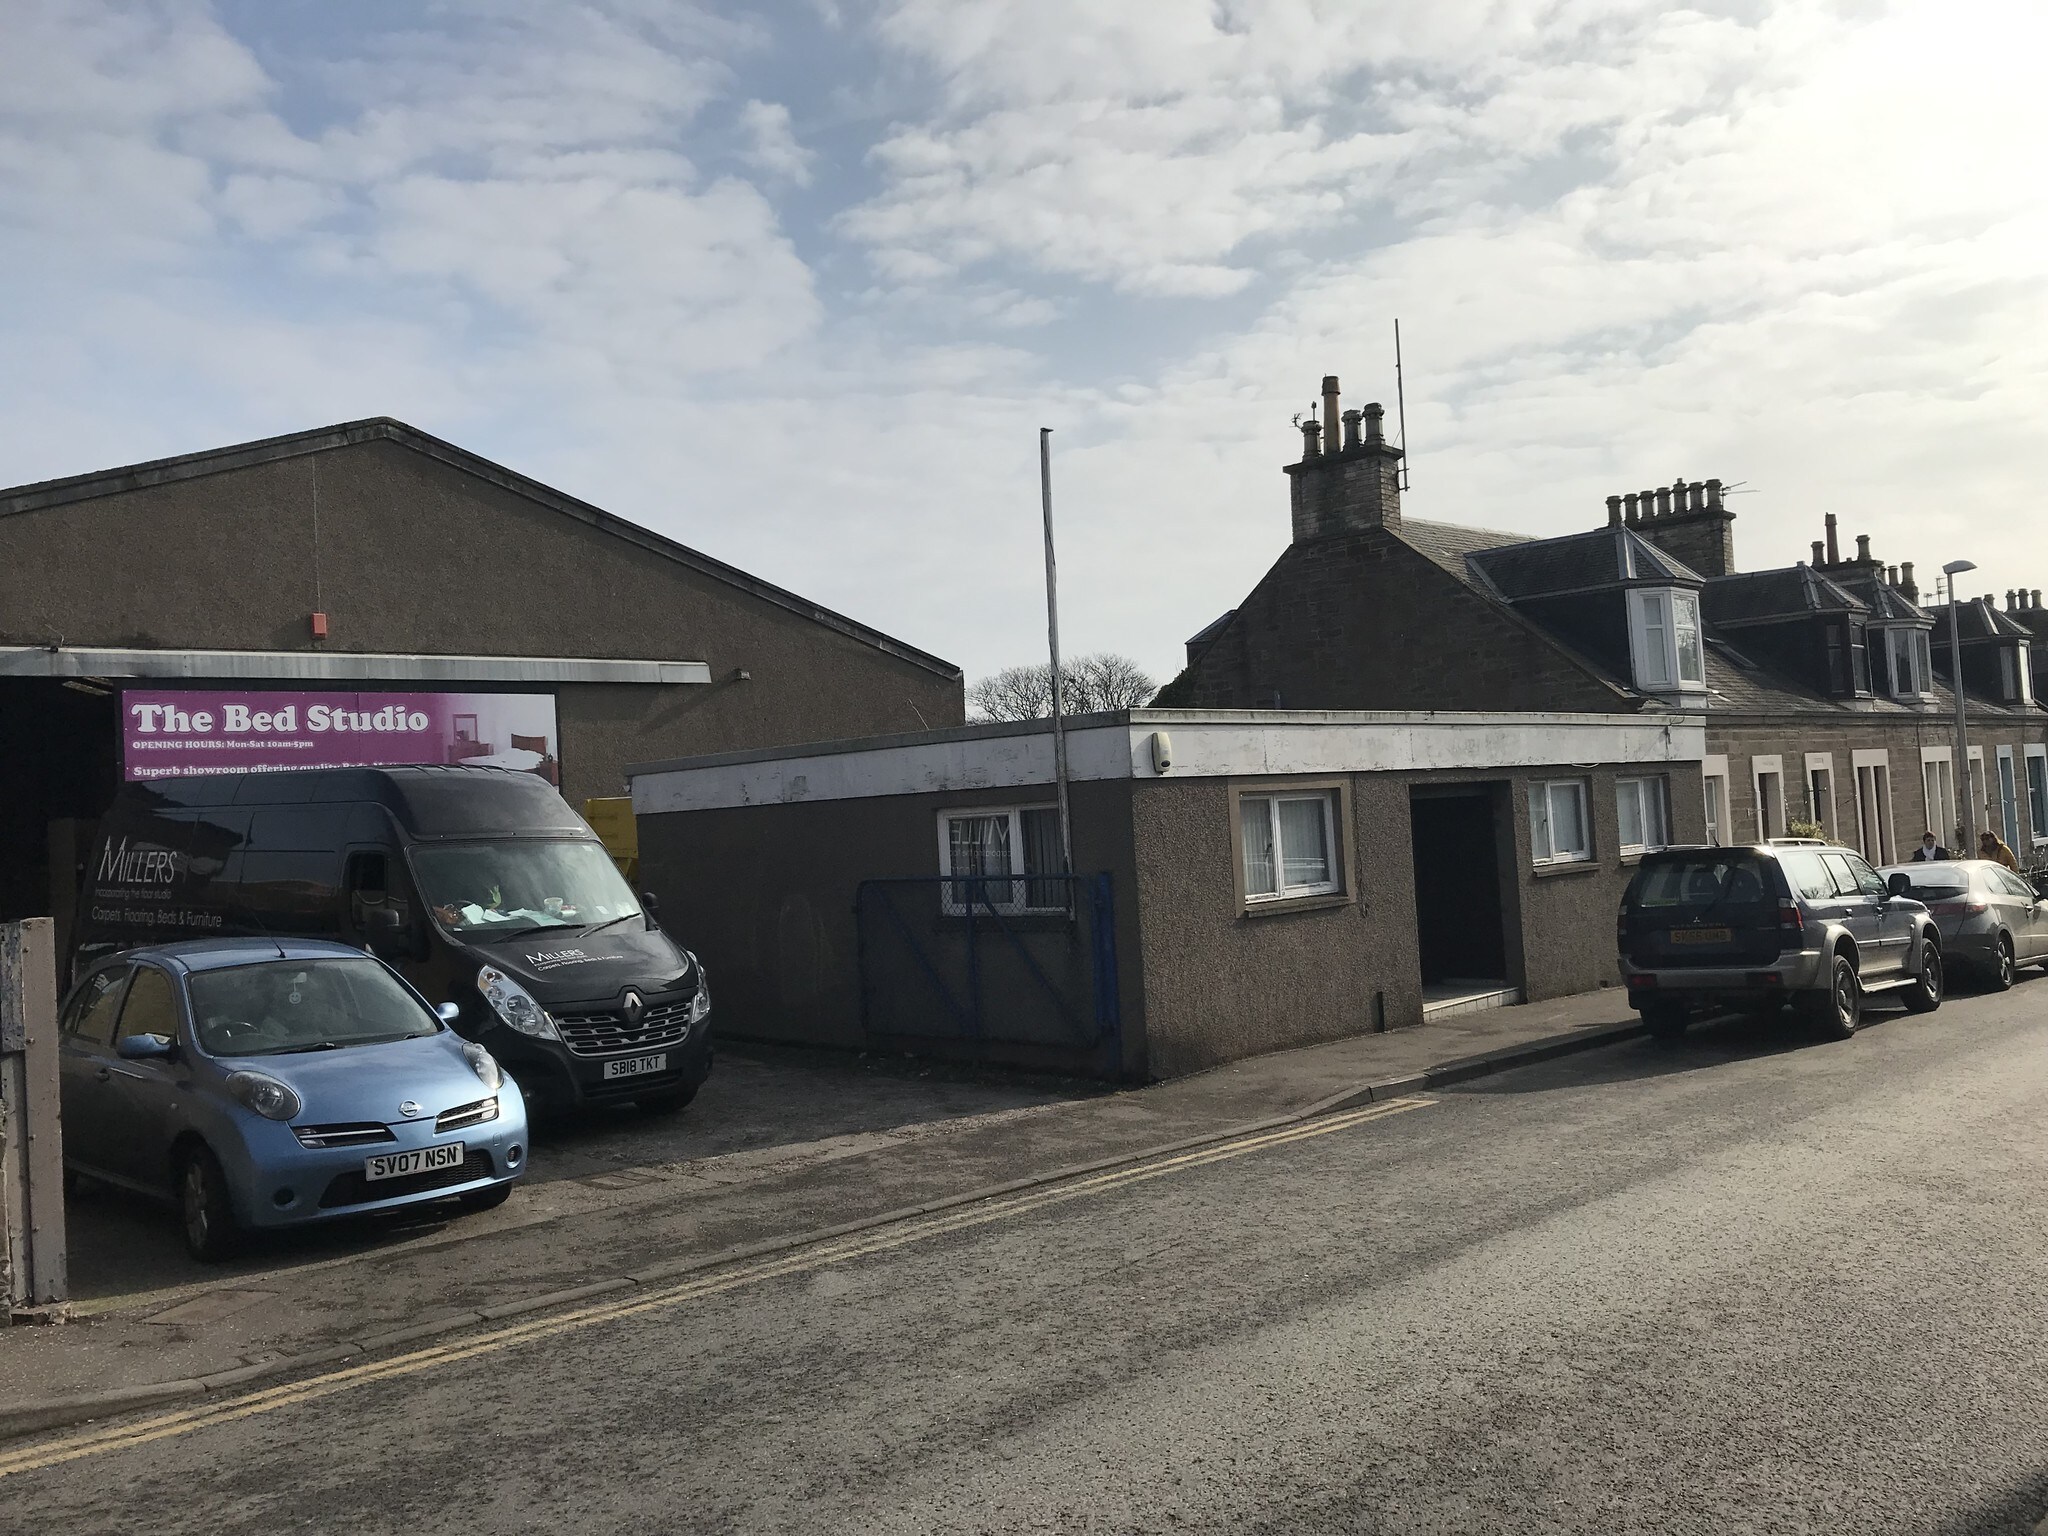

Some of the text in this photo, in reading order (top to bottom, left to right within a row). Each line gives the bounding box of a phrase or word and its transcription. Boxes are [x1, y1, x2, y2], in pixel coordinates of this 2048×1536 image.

[131, 704, 429, 732] The Bed Studio
[132, 740, 313, 749] OPENING HOURS: Mon-Sat 10am-5pm
[133, 766, 180, 778] Superb
[183, 764, 248, 775] showroom
[98, 836, 177, 883] MILLERS
[157, 910, 176, 924] Beds
[179, 912, 184, 925] &
[187, 911, 222, 927] Furniture
[525, 949, 584, 964] MILLERS
[612, 1056, 659, 1075] SB18 TKT
[375, 1147, 457, 1176] SV07 NSN
